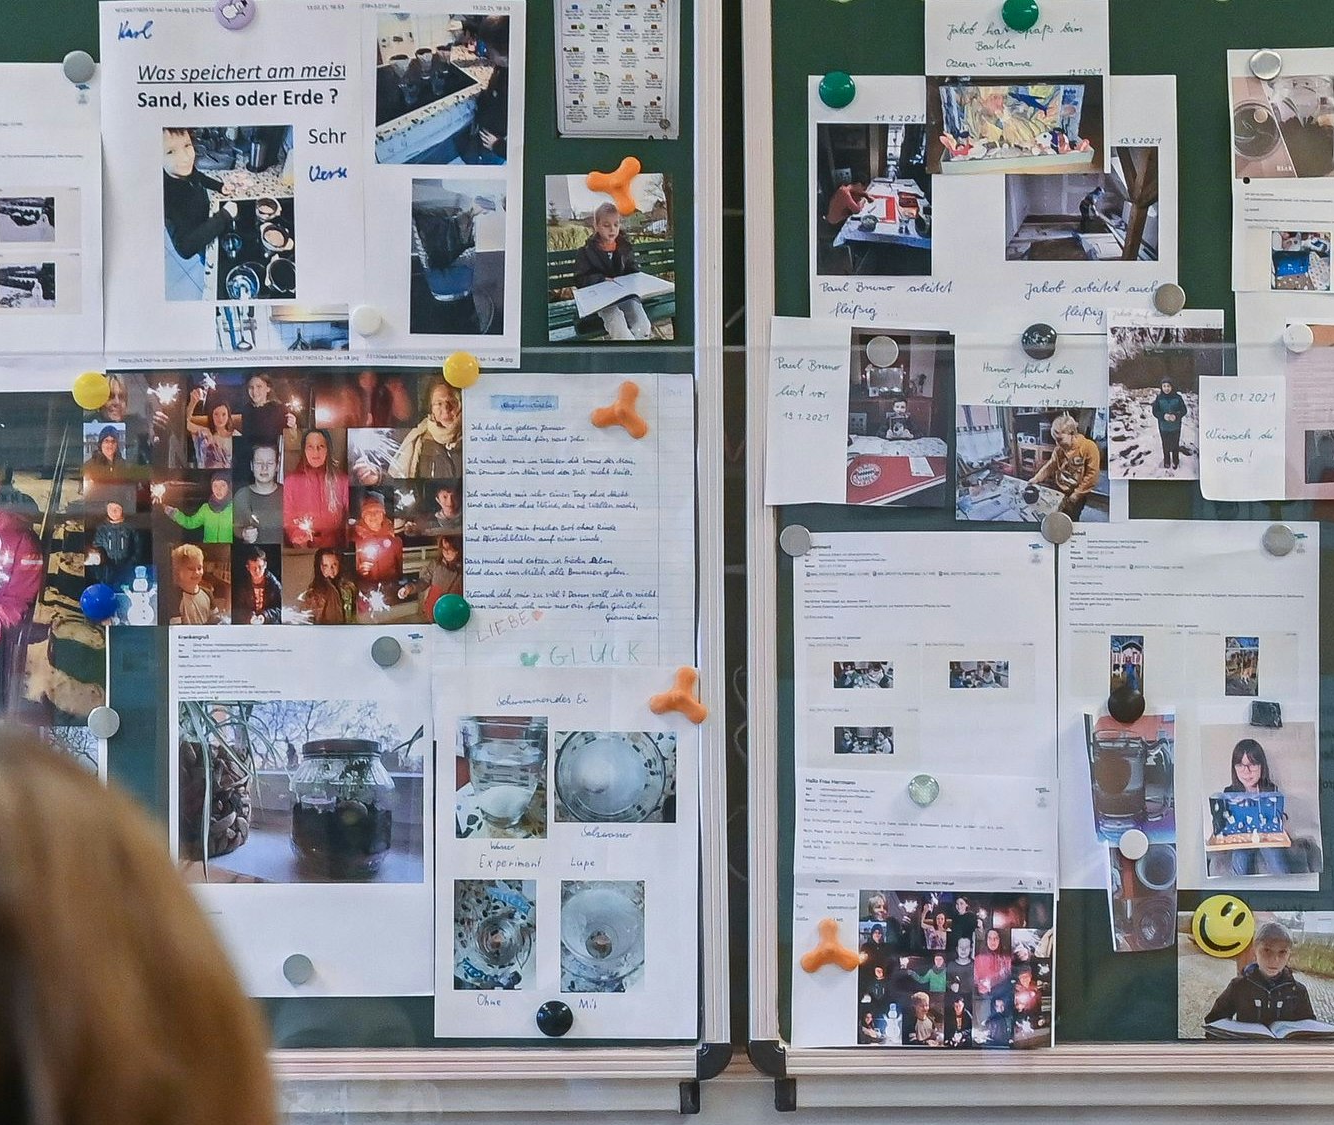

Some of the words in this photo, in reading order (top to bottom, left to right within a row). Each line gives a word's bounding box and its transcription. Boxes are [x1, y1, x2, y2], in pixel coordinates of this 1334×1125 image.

[138, 65, 175, 81] Was
[180, 64, 262, 82] speichert
[267, 67, 295, 79] am
[138, 91, 187, 110] Sand,
[194, 92, 229, 107] Kies
[236, 90, 277, 106] oder
[284, 89, 323, 105] Erde
[330, 88, 338, 104] ?
[309, 128, 346, 144] Schr
[476, 610, 530, 643] LIEBE
[549, 631, 641, 666] GLÜCK
[570, 857, 596, 871] Lupe
